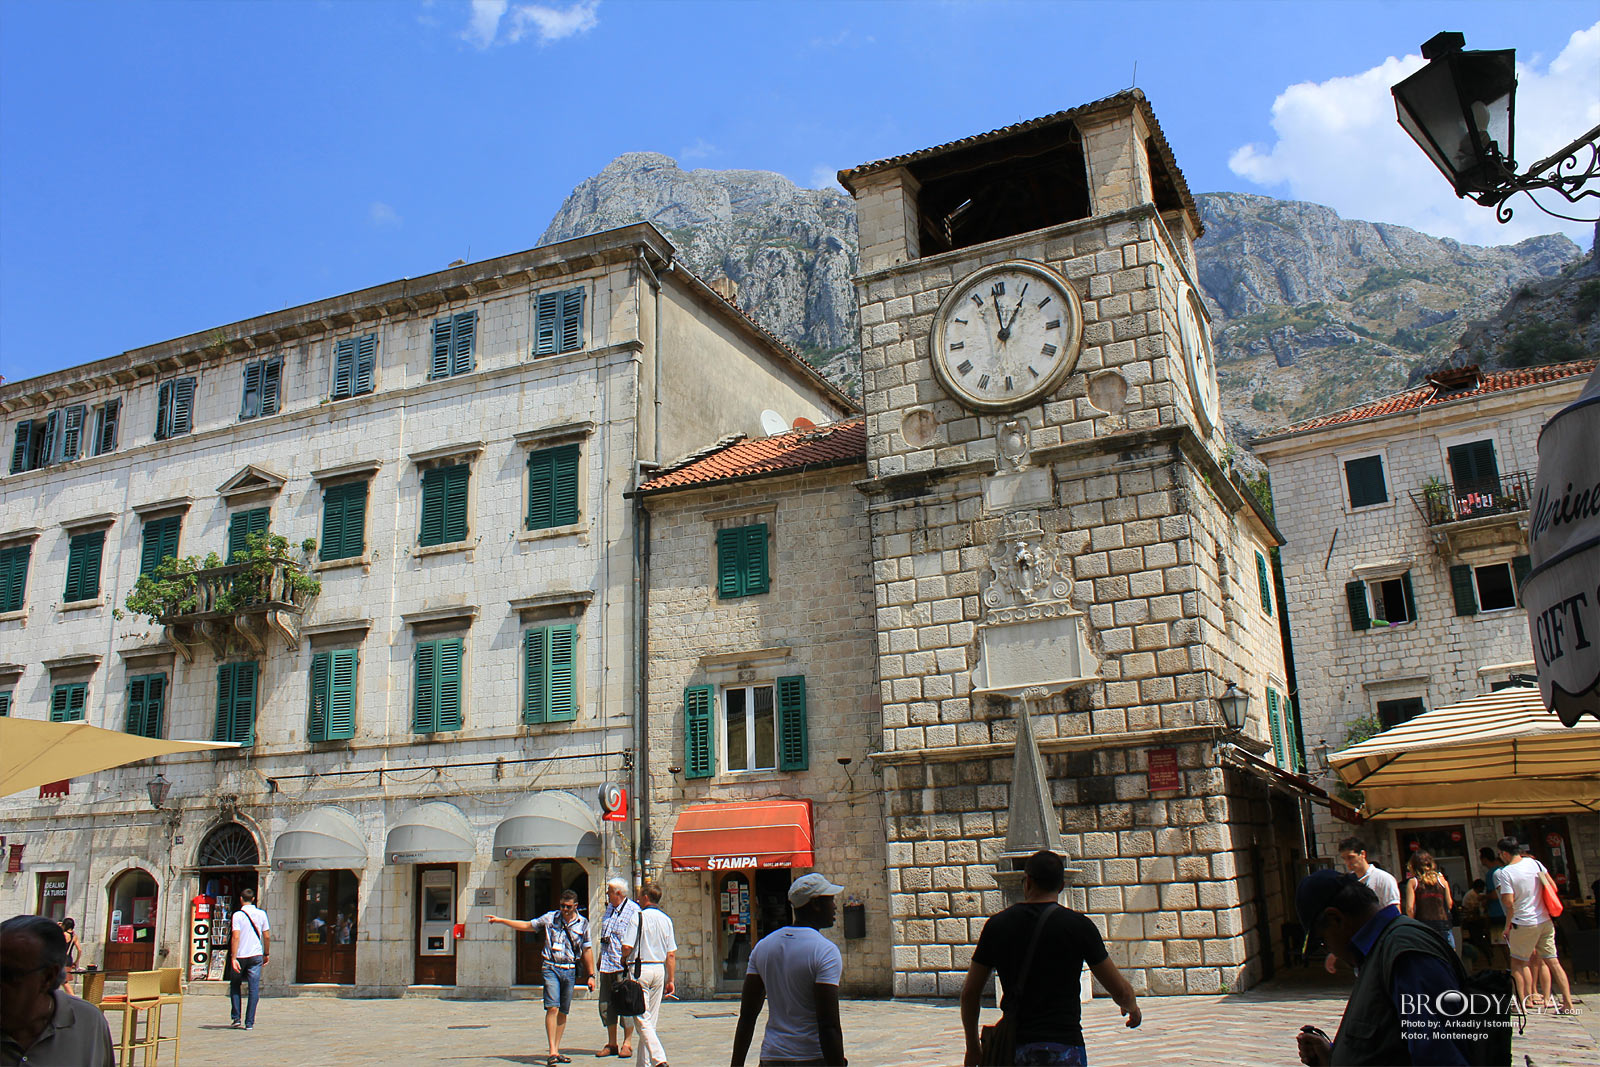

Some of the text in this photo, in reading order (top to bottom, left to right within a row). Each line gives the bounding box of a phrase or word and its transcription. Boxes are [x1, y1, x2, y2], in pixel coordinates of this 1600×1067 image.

[1537, 592, 1591, 667] GIFT
[707, 856, 758, 870] ŠTAMPA
[194, 918, 209, 963] OTO
